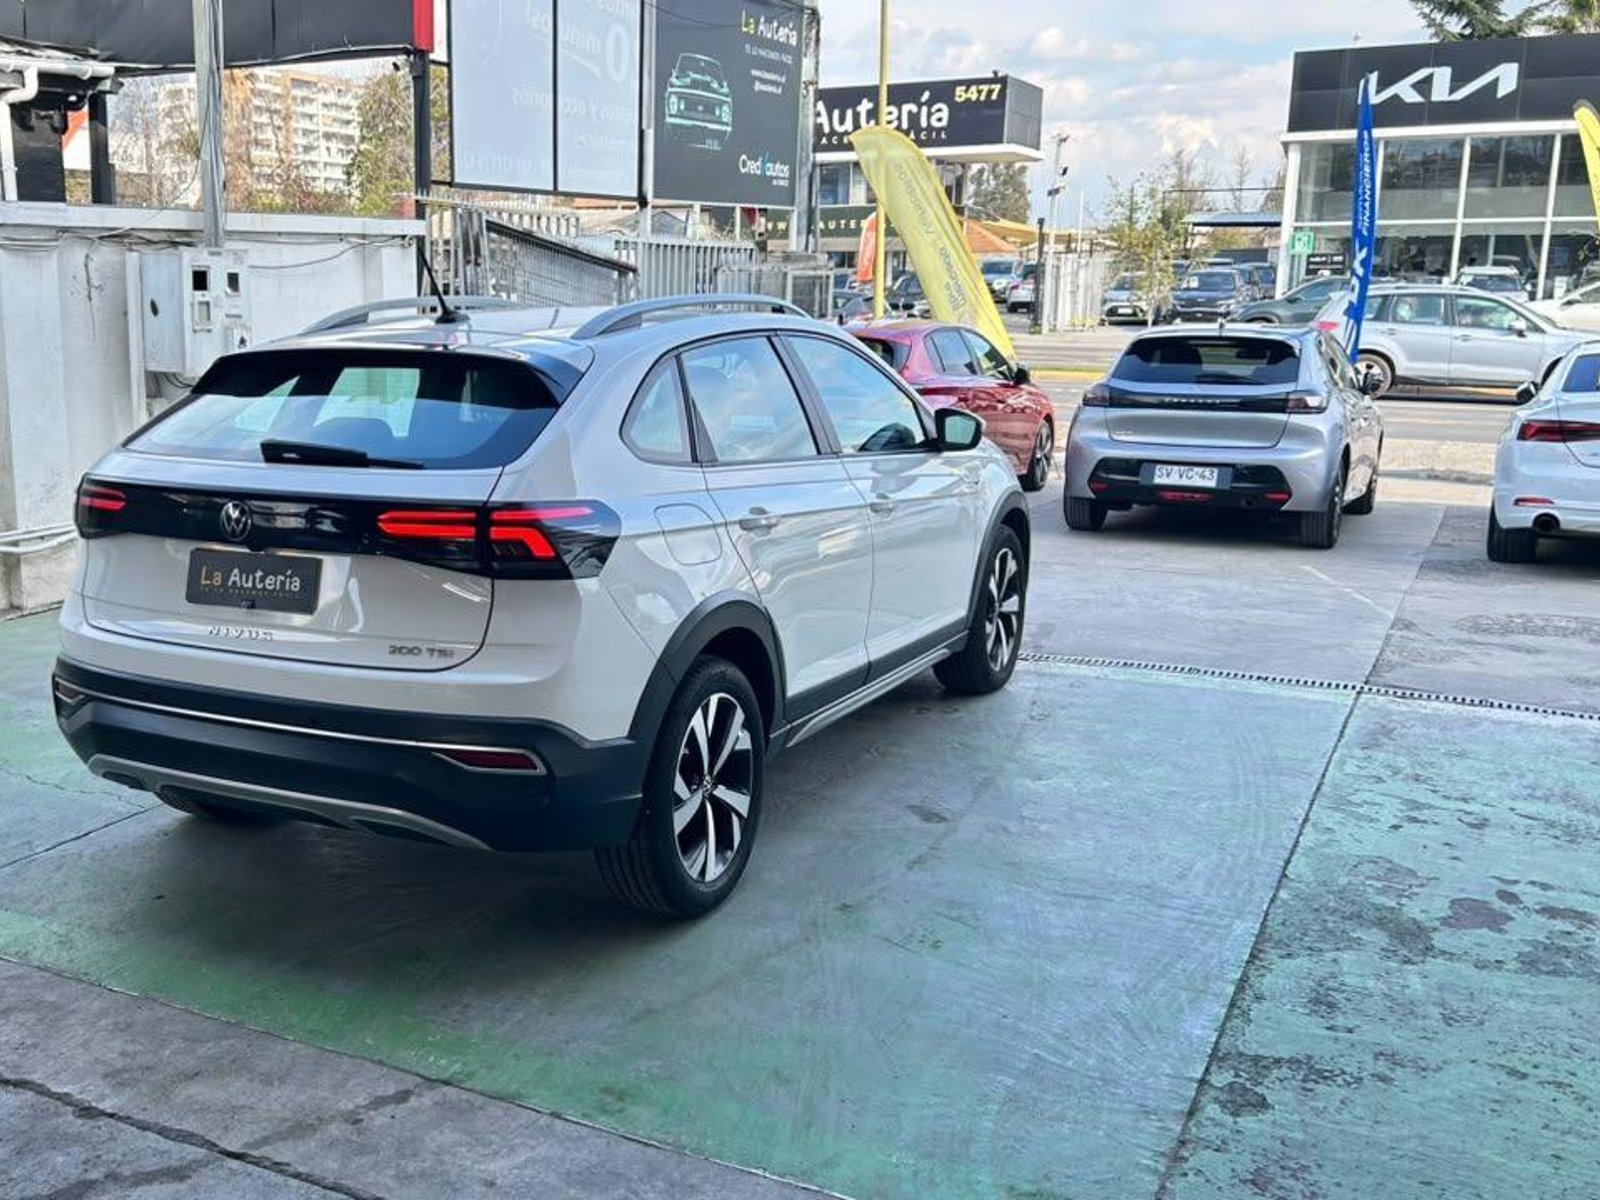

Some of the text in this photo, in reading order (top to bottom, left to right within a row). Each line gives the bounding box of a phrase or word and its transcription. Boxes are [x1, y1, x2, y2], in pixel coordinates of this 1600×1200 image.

[741, 9, 755, 34] La
[953, 83, 1002, 103] 5477
[1358, 62, 1520, 106] KIA
[815, 90, 950, 135] Autería
[201, 565, 301, 592] La Autería
[388, 644, 422, 657] 200
